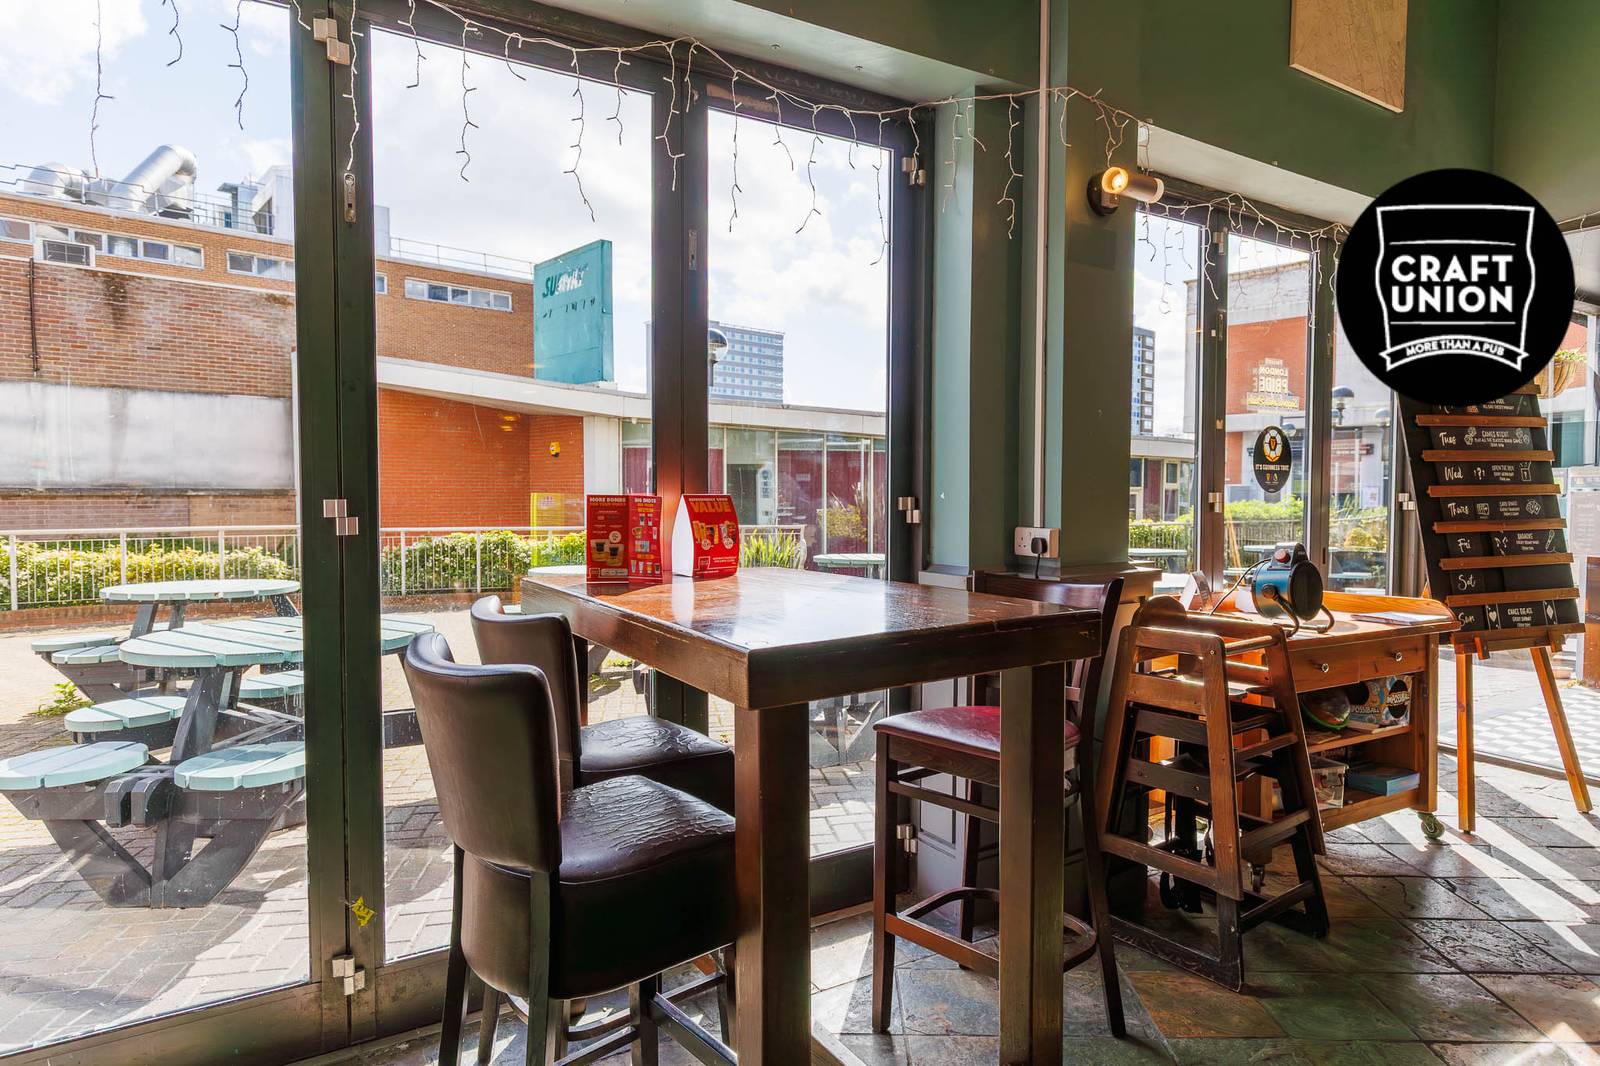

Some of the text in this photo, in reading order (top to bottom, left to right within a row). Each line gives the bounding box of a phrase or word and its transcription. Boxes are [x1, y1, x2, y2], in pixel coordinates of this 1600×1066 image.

[1439, 431, 1457, 446] Tues
[1444, 466, 1463, 480] Wed
[690, 501, 732, 513] VALUE
[1458, 538, 1471, 553] Fri
[1457, 574, 1476, 591] Sat
